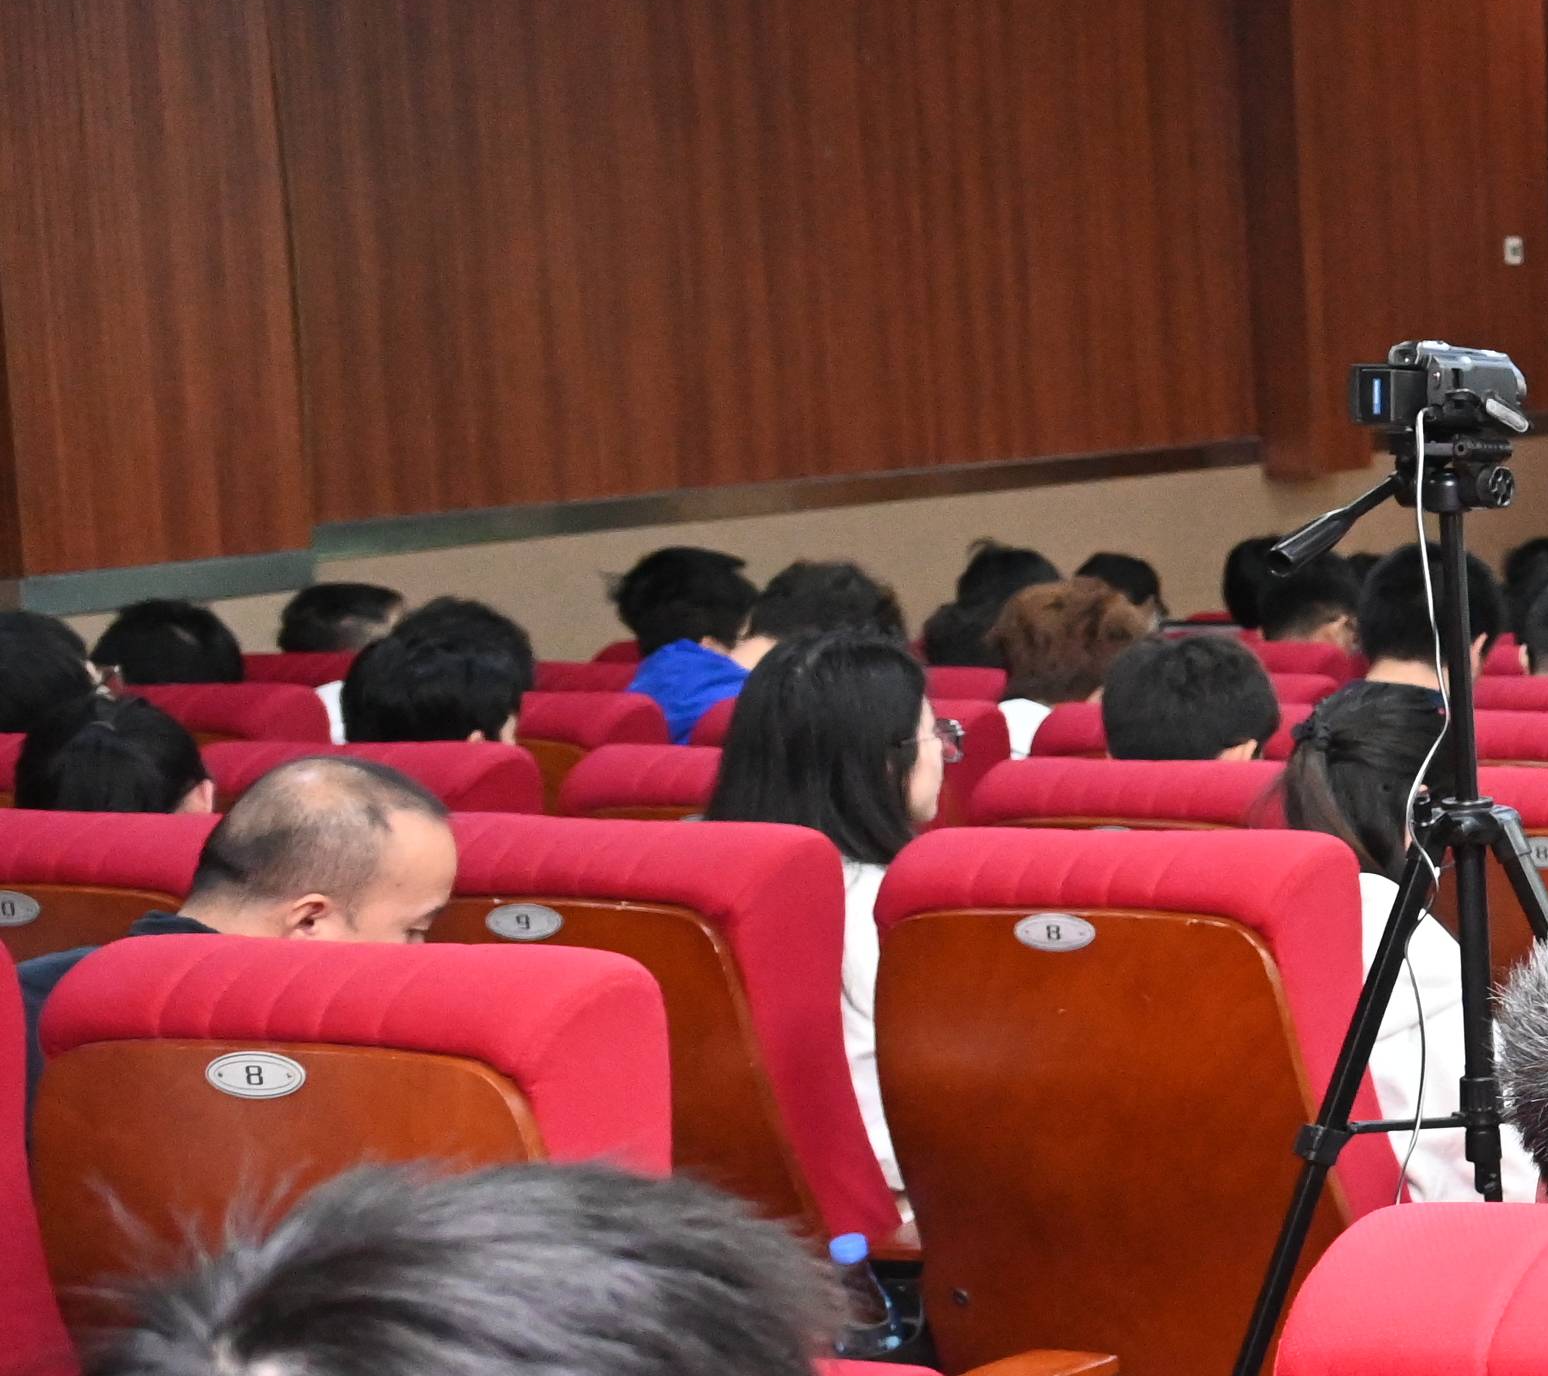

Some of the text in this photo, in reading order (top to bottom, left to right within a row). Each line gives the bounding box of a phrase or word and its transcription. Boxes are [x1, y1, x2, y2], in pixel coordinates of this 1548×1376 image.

[515, 914, 530, 930] 9
[1046, 924, 1060, 940] 8
[246, 1064, 263, 1086] 8
